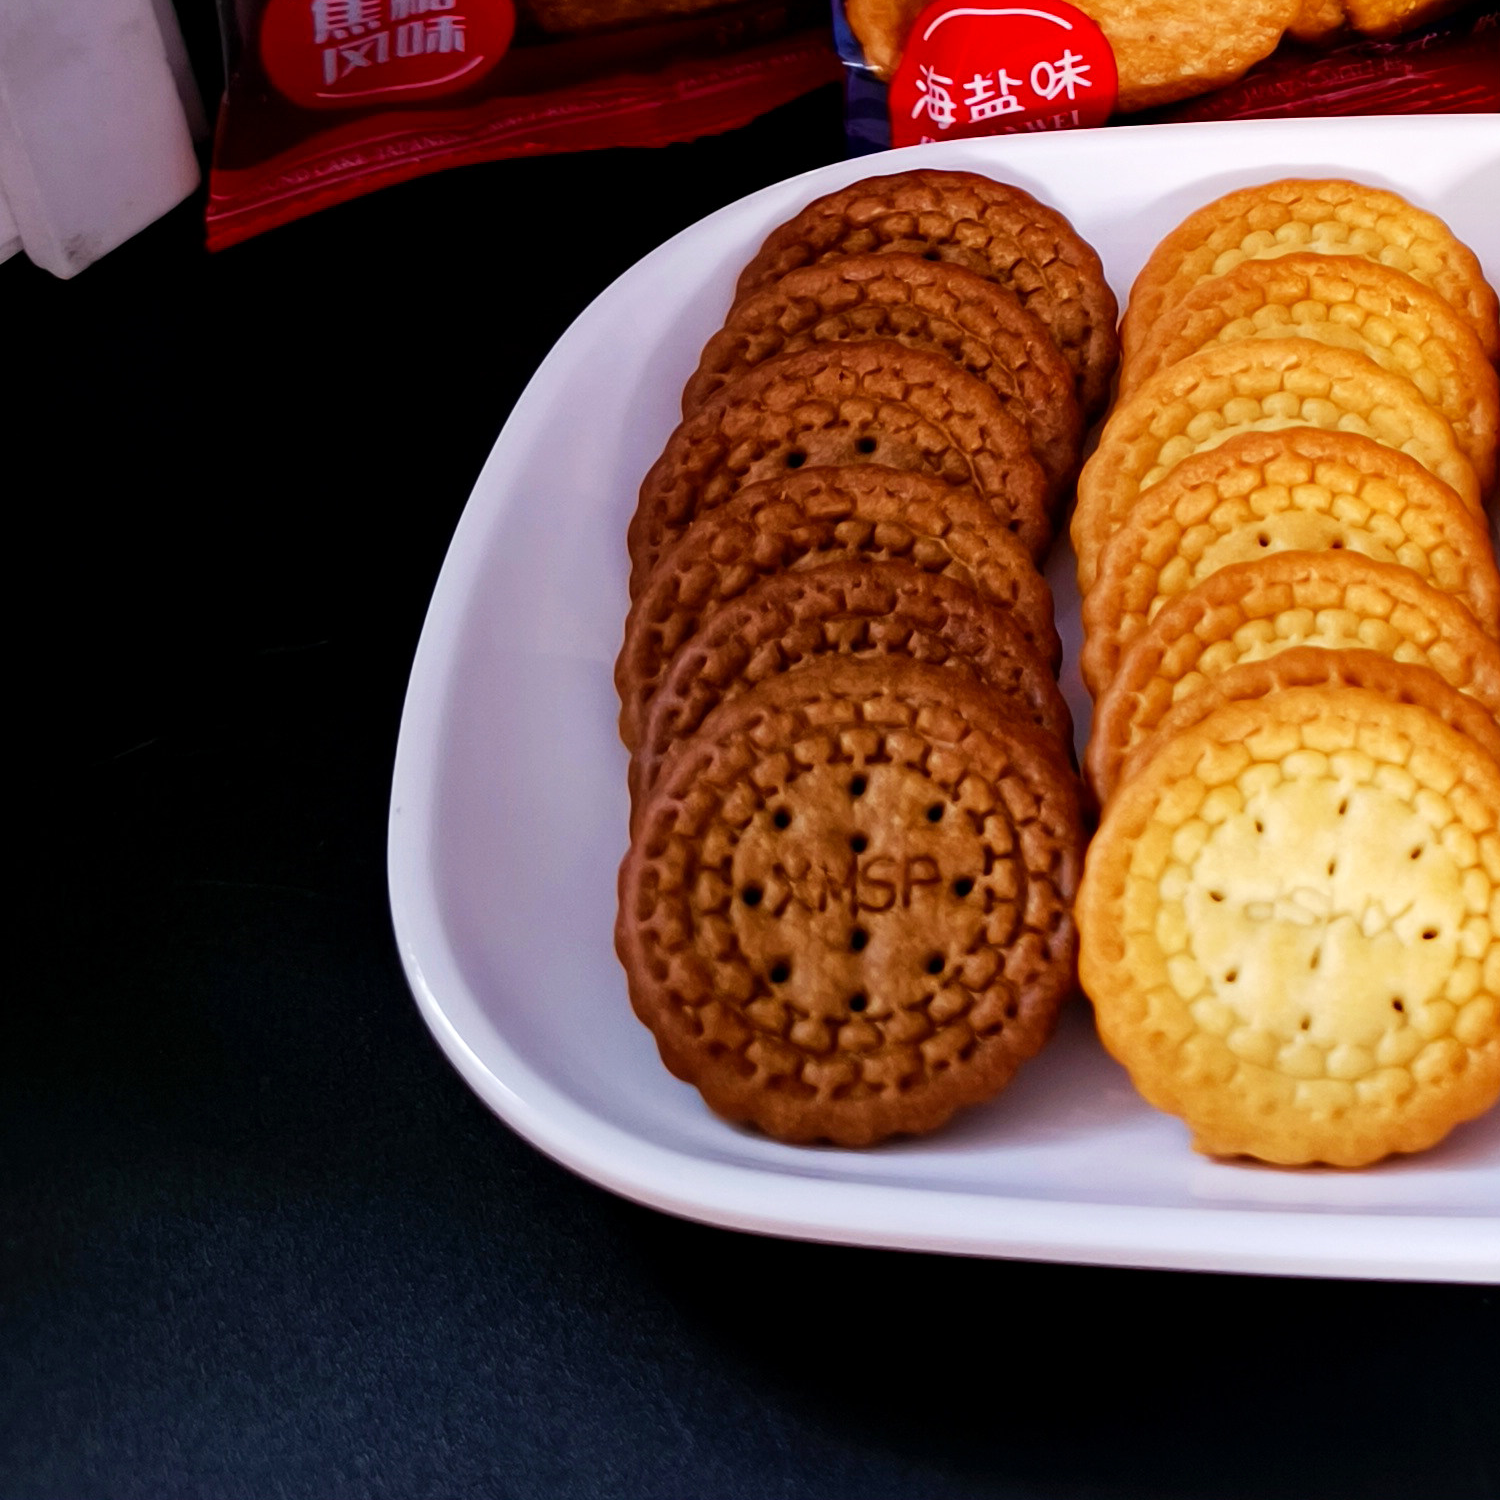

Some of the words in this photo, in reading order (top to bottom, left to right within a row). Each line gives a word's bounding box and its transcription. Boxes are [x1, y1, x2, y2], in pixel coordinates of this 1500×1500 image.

[322, 15, 467, 86] 风味
[911, 48, 1094, 131] 海盐味
